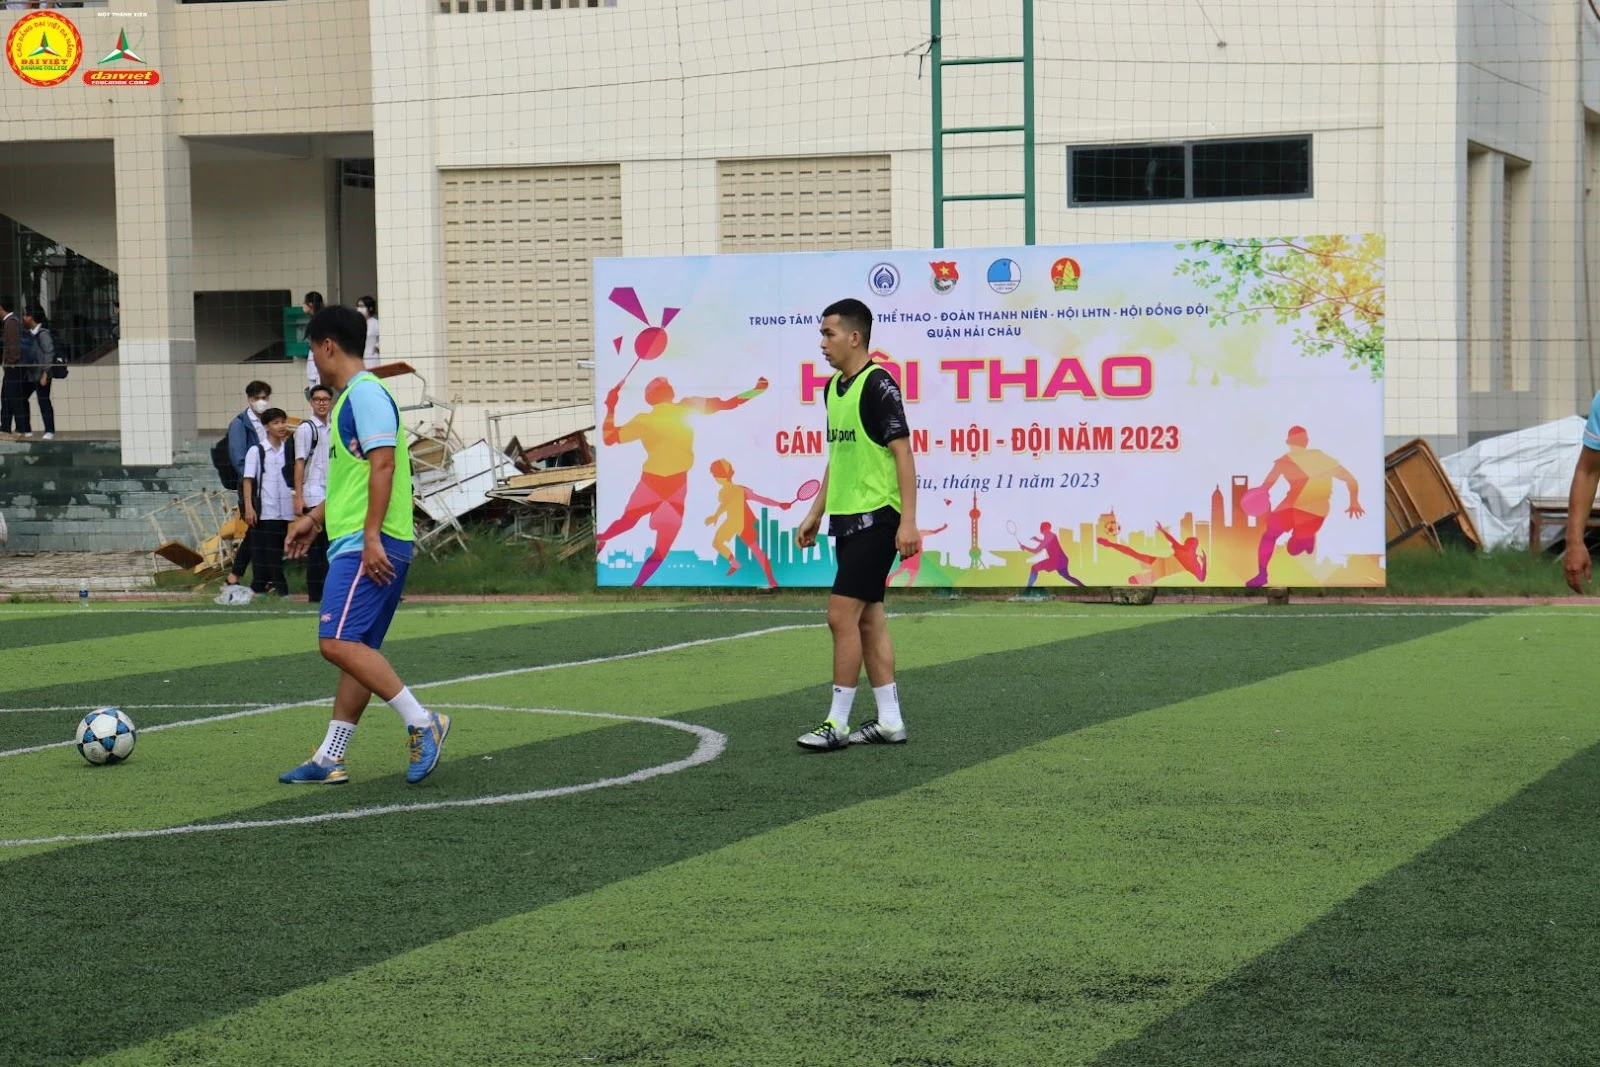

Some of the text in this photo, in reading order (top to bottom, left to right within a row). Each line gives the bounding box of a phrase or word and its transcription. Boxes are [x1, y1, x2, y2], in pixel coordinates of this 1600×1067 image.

[749, 316, 787, 326] TRUNG
[790, 313, 813, 325] TÂM
[878, 308, 898, 323] THỂ
[901, 312, 931, 323] THAO
[941, 309, 975, 322] ĐOÀN
[978, 311, 1018, 321] THANH
[1021, 307, 1048, 320] NIÊN
[1057, 306, 1079, 321] HỘI
[1082, 308, 1111, 318] LHTN
[1120, 305, 1143, 319] HỘI
[1145, 302, 1183, 316] ĐỒNG
[1186, 303, 1209, 318] ĐỘI
[927, 323, 1021, 341] QUẬN HẢI CHÂU
[940, 355, 1153, 401] THAO
[776, 425, 823, 456] CÁN
[950, 424, 989, 459] HỘI
[1011, 423, 1051, 458] ĐỘI
[1058, 421, 1114, 452] NĂM
[1120, 425, 1179, 452] 2023
[943, 473, 990, 493] tháng
[996, 474, 1013, 488] 11
[1018, 473, 1055, 488] năm
[1060, 472, 1100, 488] 2023
